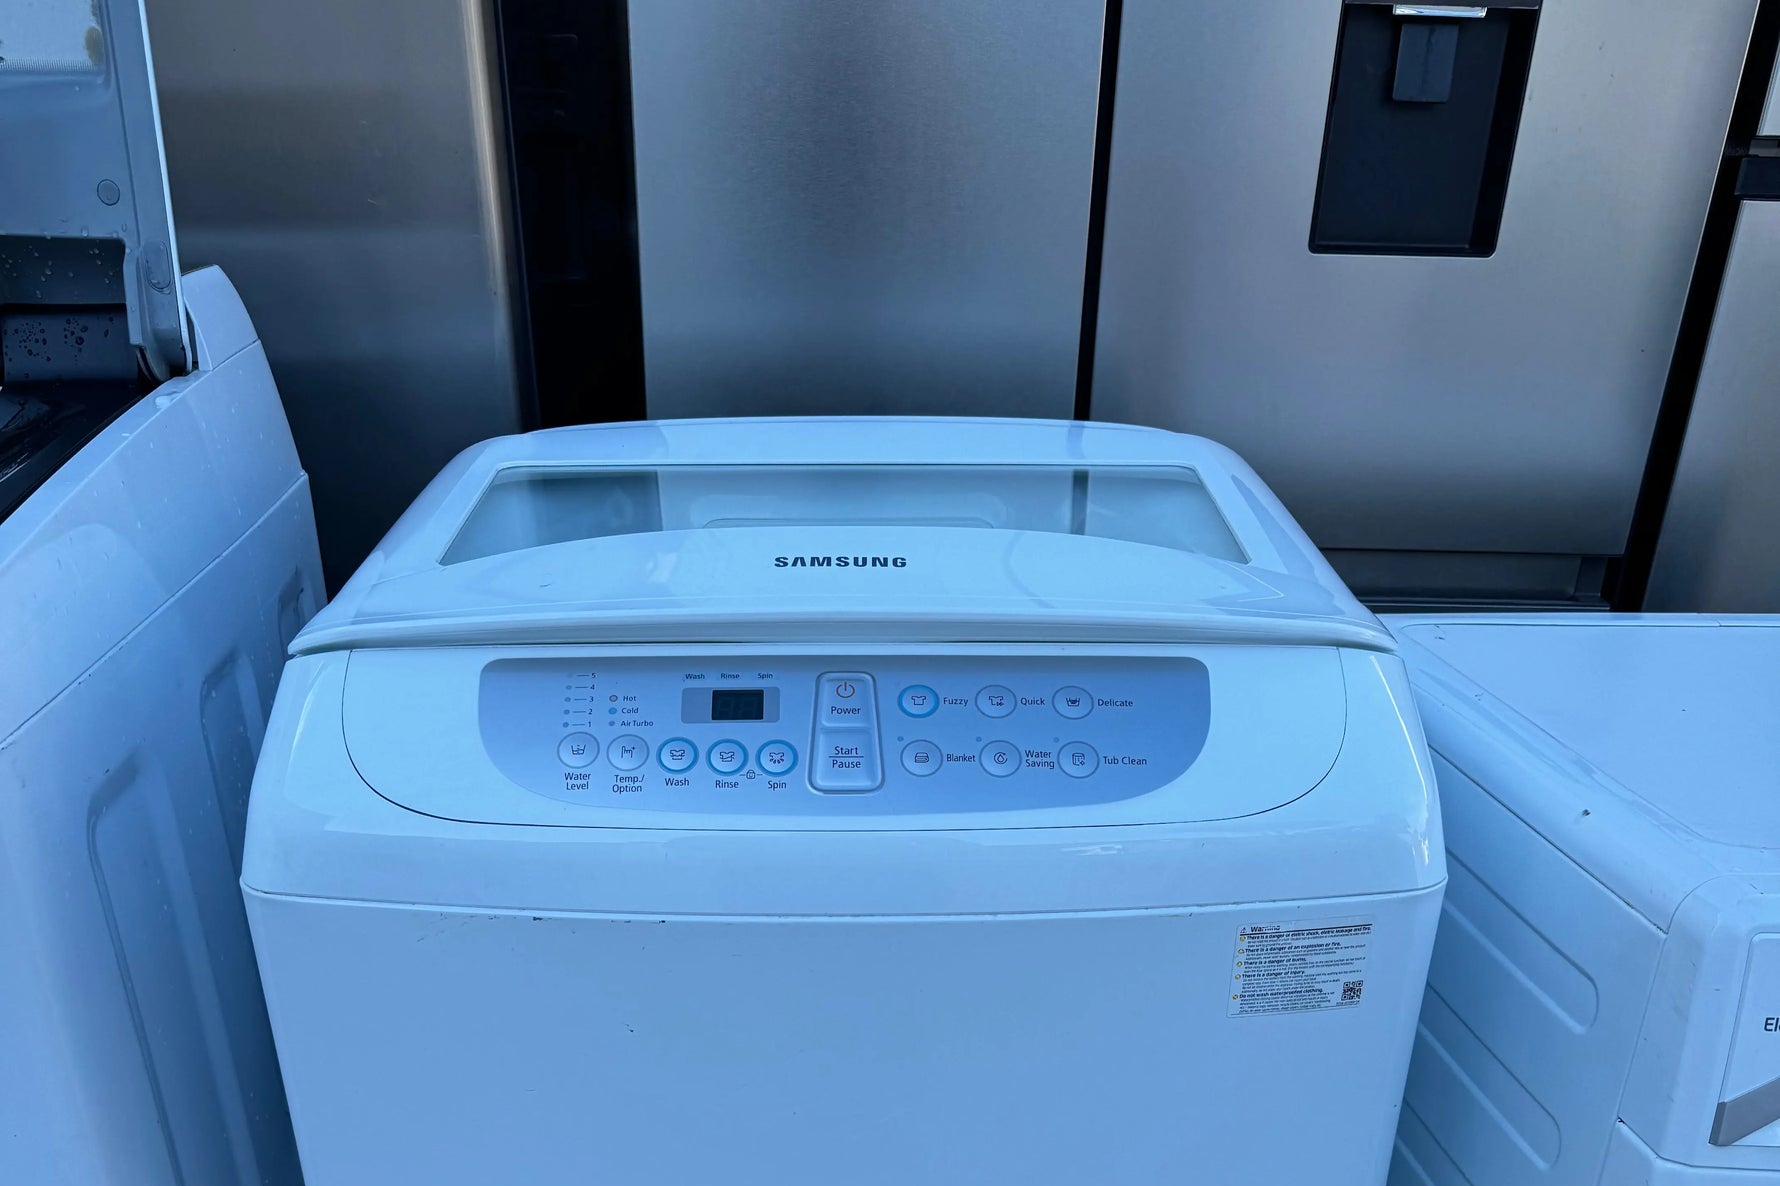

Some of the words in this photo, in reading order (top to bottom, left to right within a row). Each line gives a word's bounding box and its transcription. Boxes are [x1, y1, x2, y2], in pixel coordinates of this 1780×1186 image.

[774, 556, 907, 568] SAMSUNG
[757, 672, 773, 680] Spin
[943, 697, 969, 706] Fuzzy
[1020, 697, 1045, 706] Quick
[1097, 698, 1134, 707] Delicate
[830, 706, 861, 715] Power
[834, 746, 859, 755] Start
[1025, 750, 1052, 758] Water
[946, 753, 976, 762] Blanket
[1103, 756, 1119, 765] Tub
[1121, 756, 1148, 765] Clean
[832, 760, 861, 769] Pause
[1025, 759, 1055, 769] Saving
[564, 772, 592, 781] Water
[614, 774, 645, 785] Temp./
[566, 781, 589, 791] Level
[664, 778, 690, 787] Wash
[715, 780, 740, 789] Rinse
[767, 780, 787, 791] Spin
[612, 784, 643, 794] Option
[1764, 1017, 1780, 1032] El
